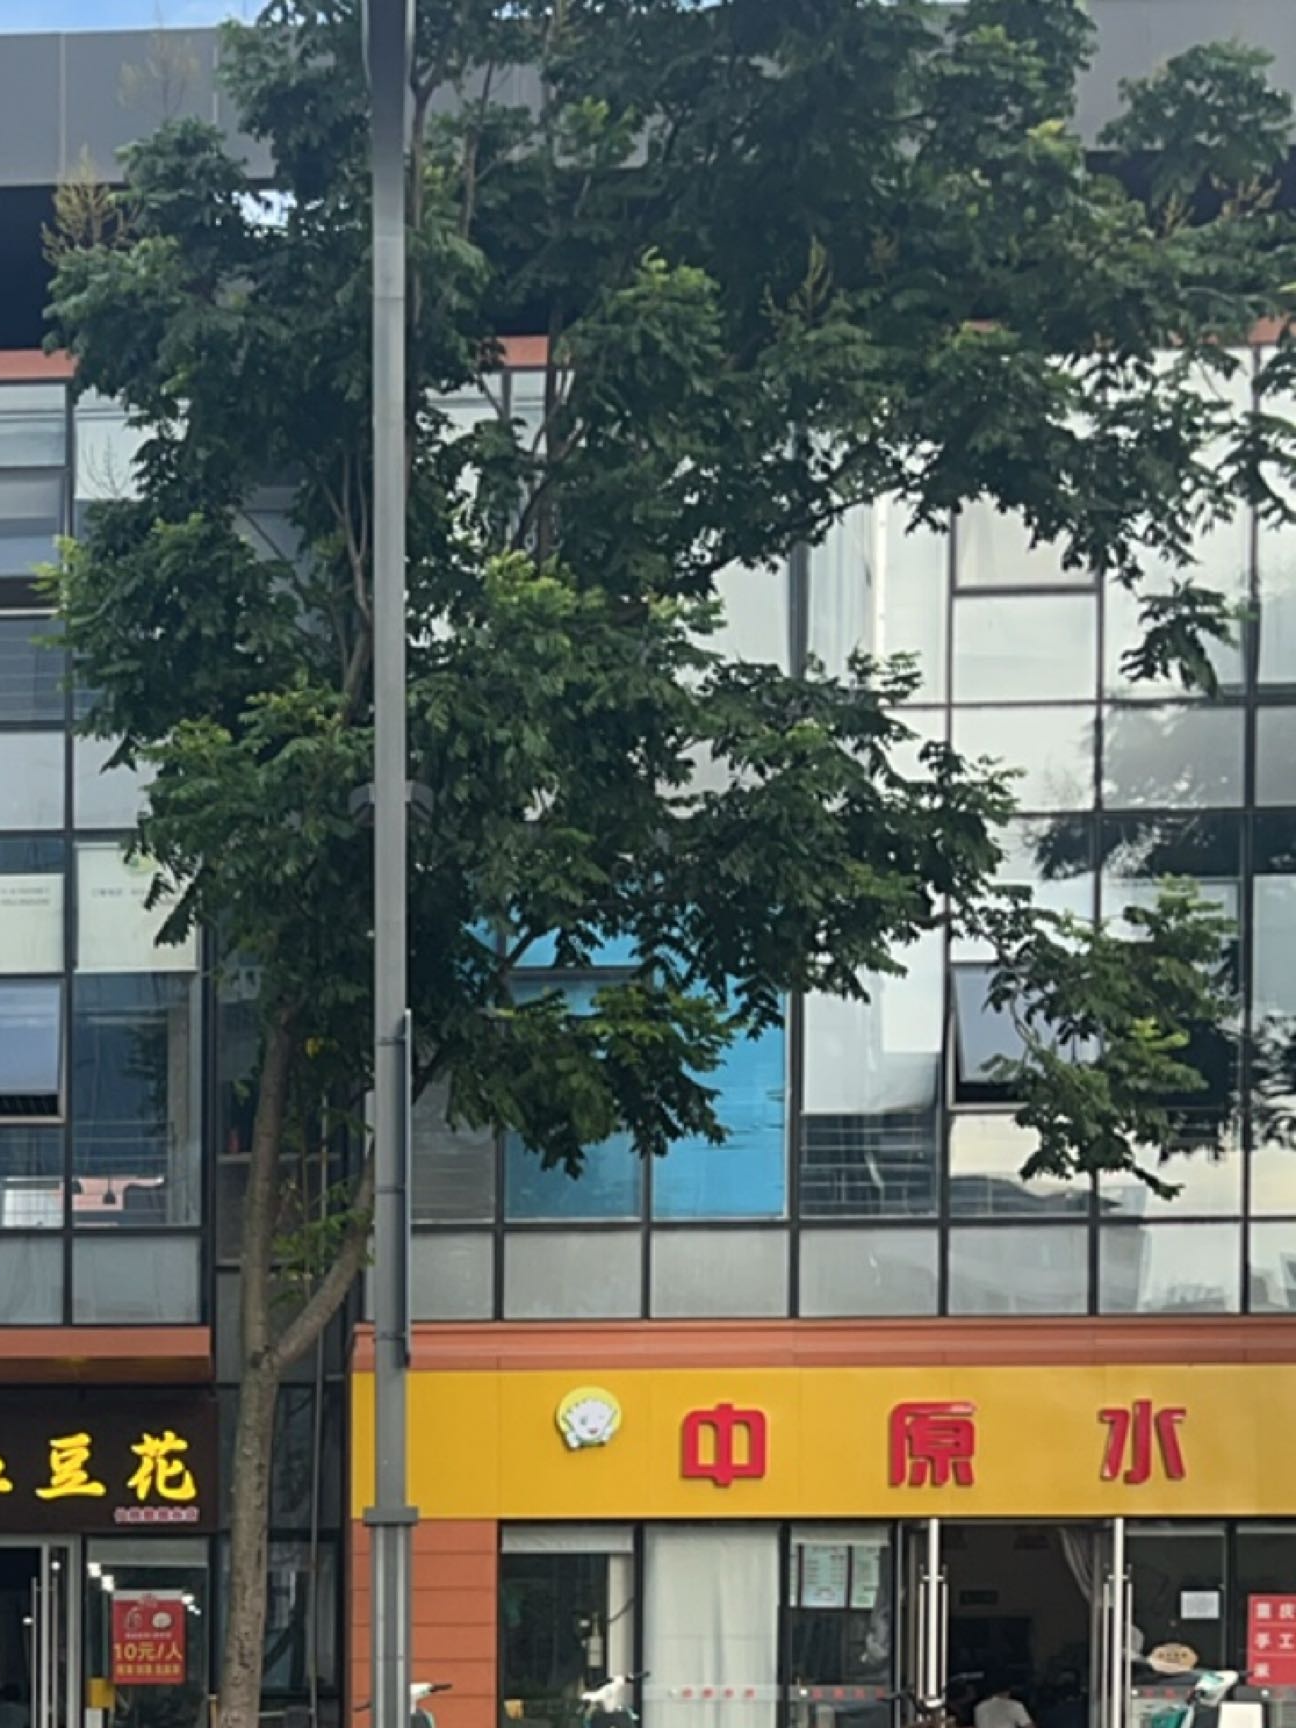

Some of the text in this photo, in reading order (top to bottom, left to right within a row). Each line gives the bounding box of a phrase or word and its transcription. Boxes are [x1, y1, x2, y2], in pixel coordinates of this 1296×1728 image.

[681, 1401, 1187, 1487] 中原水
[113, 1641, 184, 1661] 10元/人
